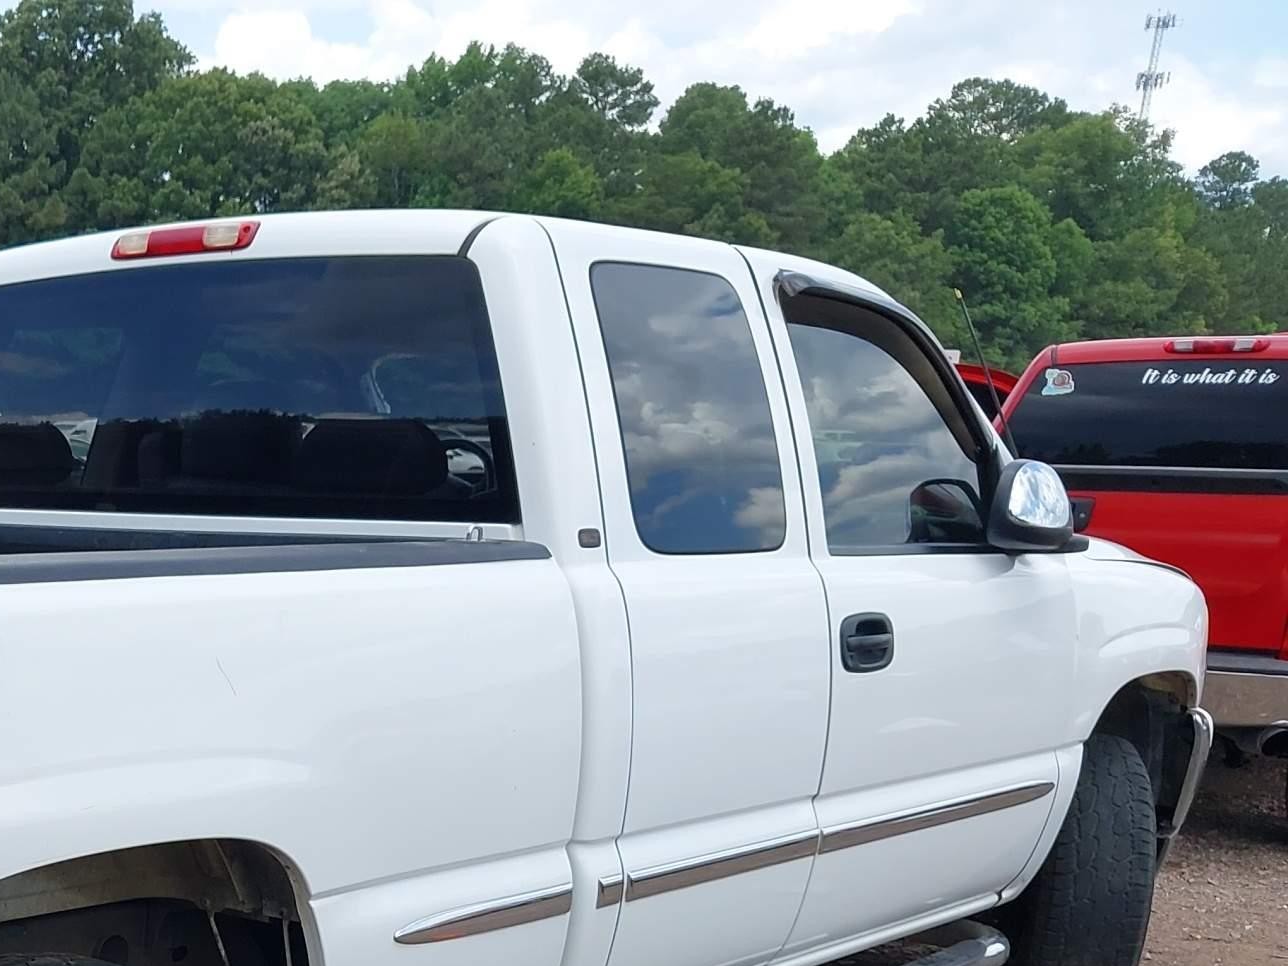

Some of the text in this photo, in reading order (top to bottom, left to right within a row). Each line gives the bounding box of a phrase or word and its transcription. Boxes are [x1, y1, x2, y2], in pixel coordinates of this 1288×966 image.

[1142, 367, 1280, 384] It is what it is
